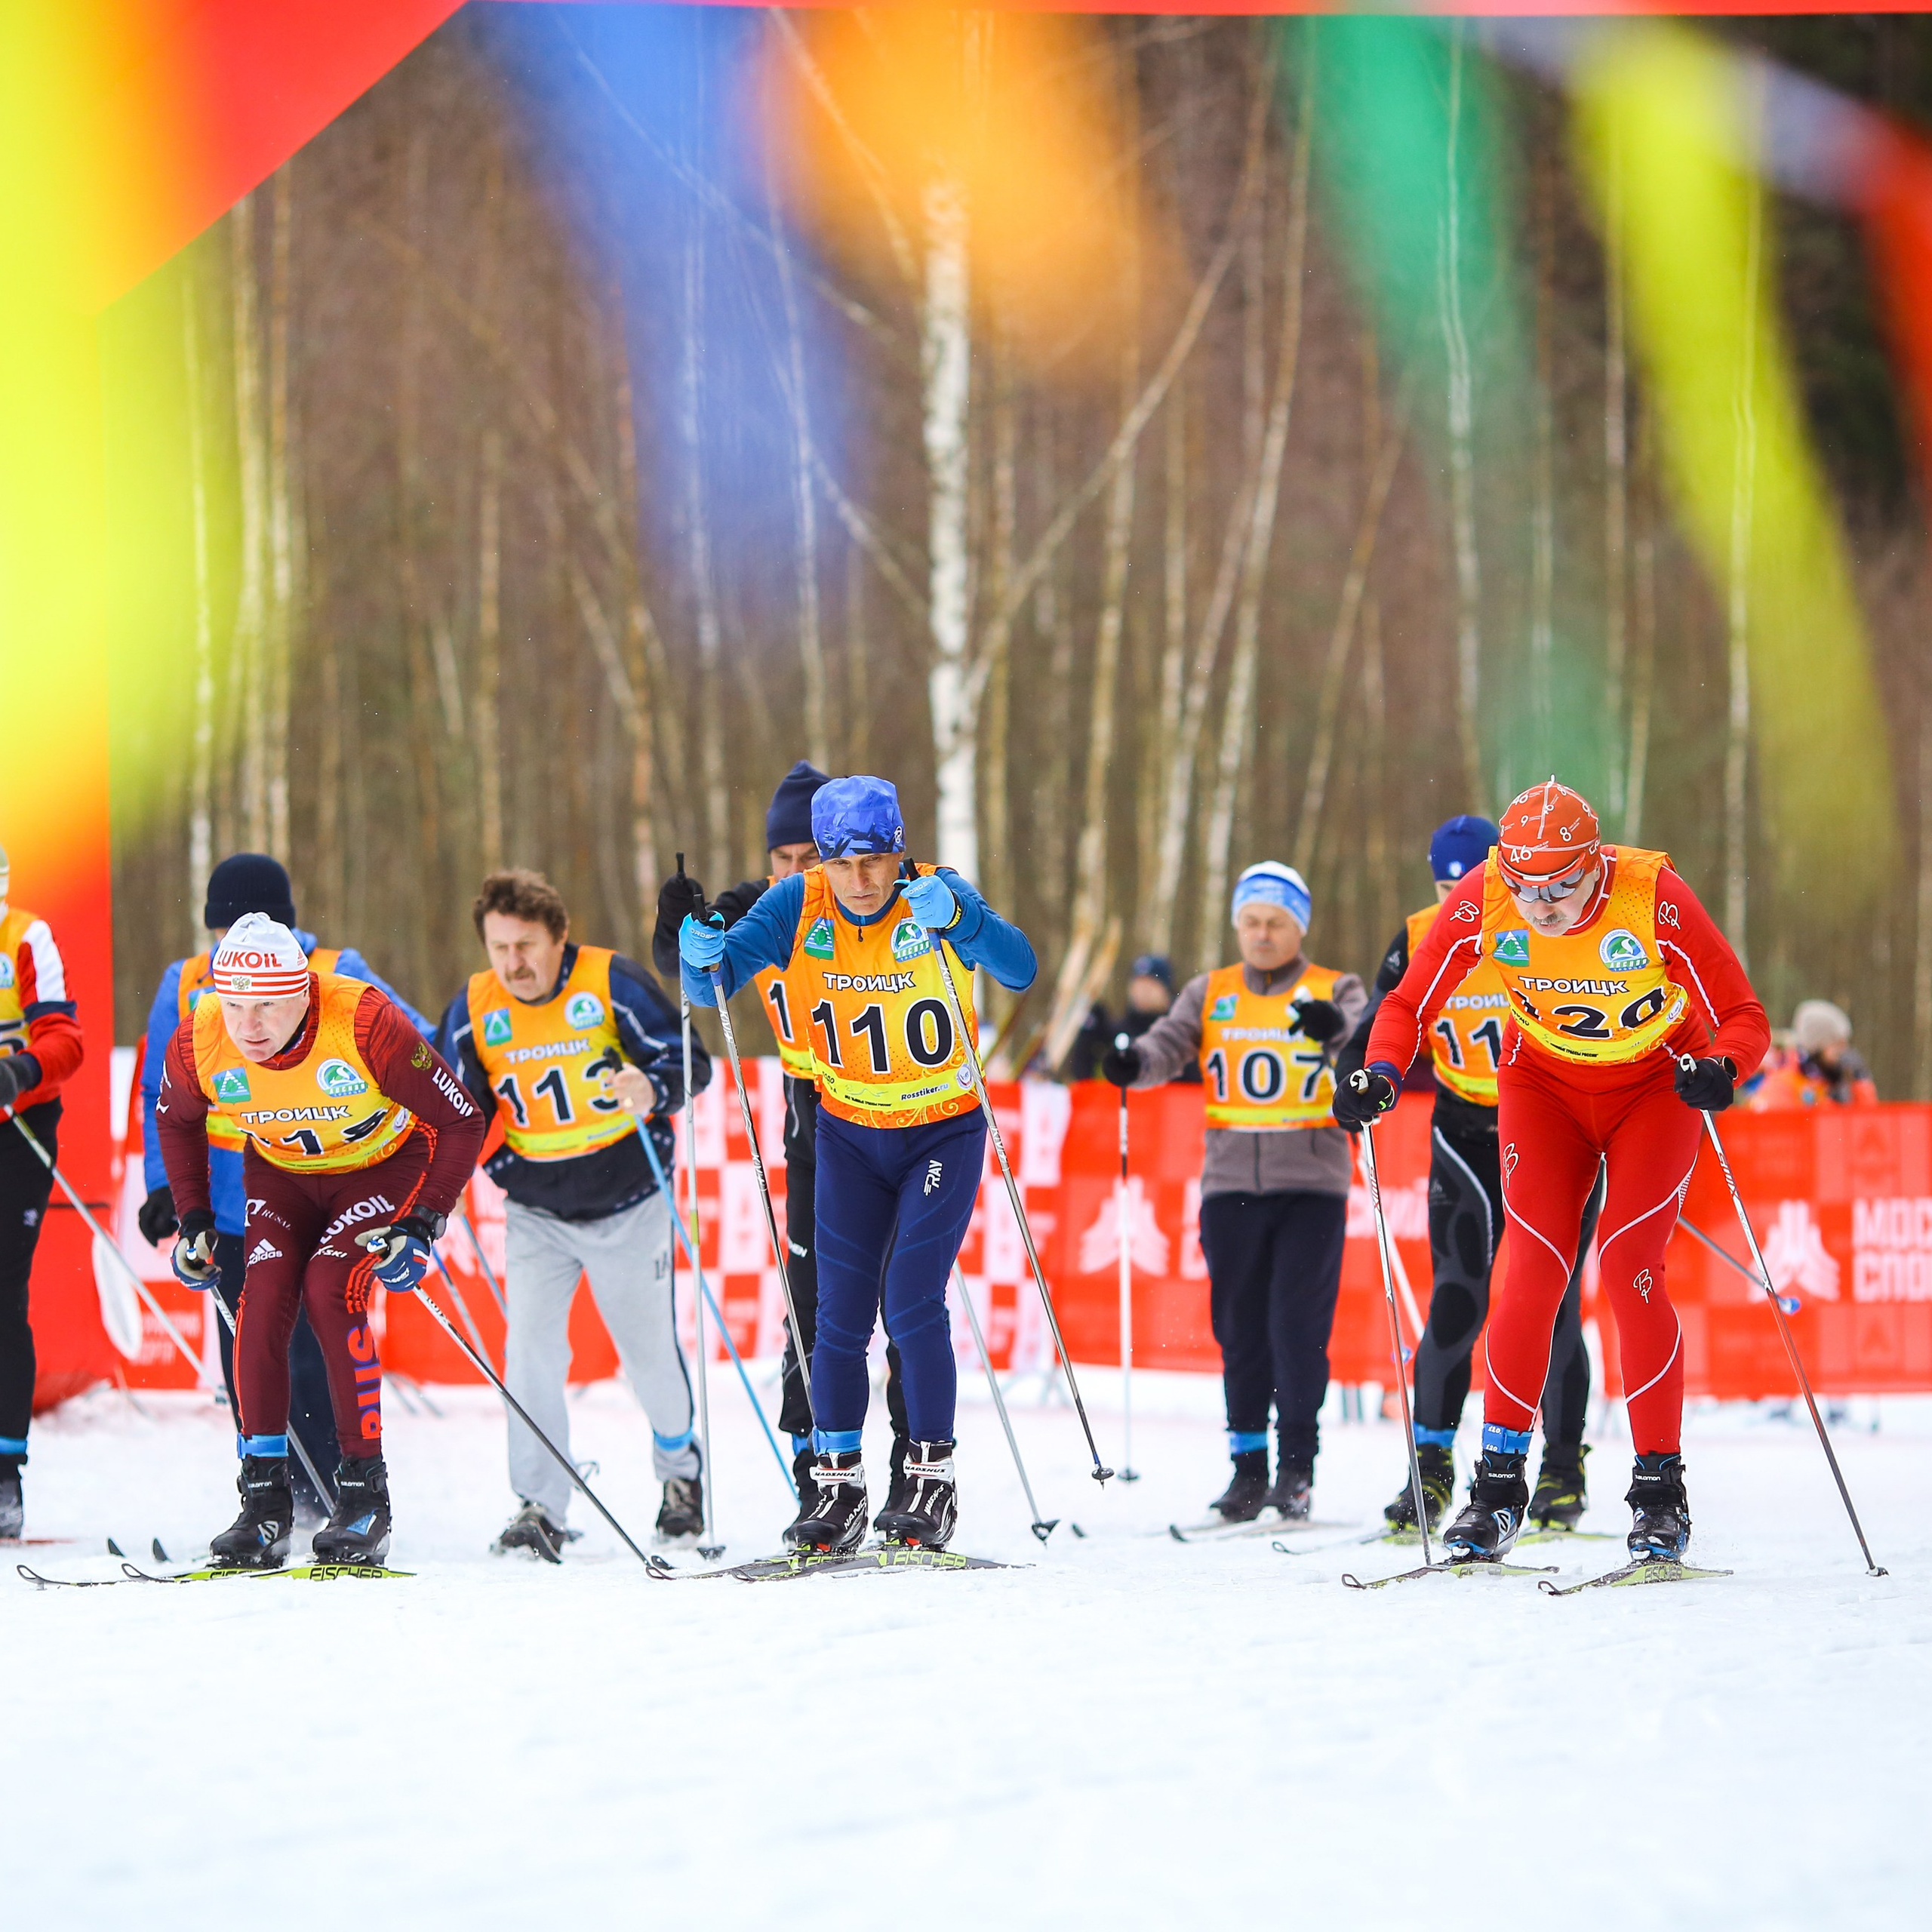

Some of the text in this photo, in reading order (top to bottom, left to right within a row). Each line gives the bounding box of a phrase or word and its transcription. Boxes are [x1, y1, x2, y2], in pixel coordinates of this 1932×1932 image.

[1559, 826, 1572, 842] 8
[1510, 844, 1533, 864] 46
[217, 949, 282, 968] LUKOIL
[823, 971, 916, 992] ТРОИЦК
[1518, 976, 1629, 995] ТРОИЦК
[811, 997, 955, 1074] 110
[504, 1038, 592, 1065] ТРОИЦК
[1205, 1047, 1326, 1106] 107
[901, 1083, 949, 1100] Rosstiker.ru
[241, 1105, 352, 1124] ТРОИЦК
[319, 1194, 396, 1244] LUKOIL
[246, 1251, 284, 1268] adidas
[893, 1550, 967, 1567] FISCHER
[309, 1567, 383, 1580] FISCHER
